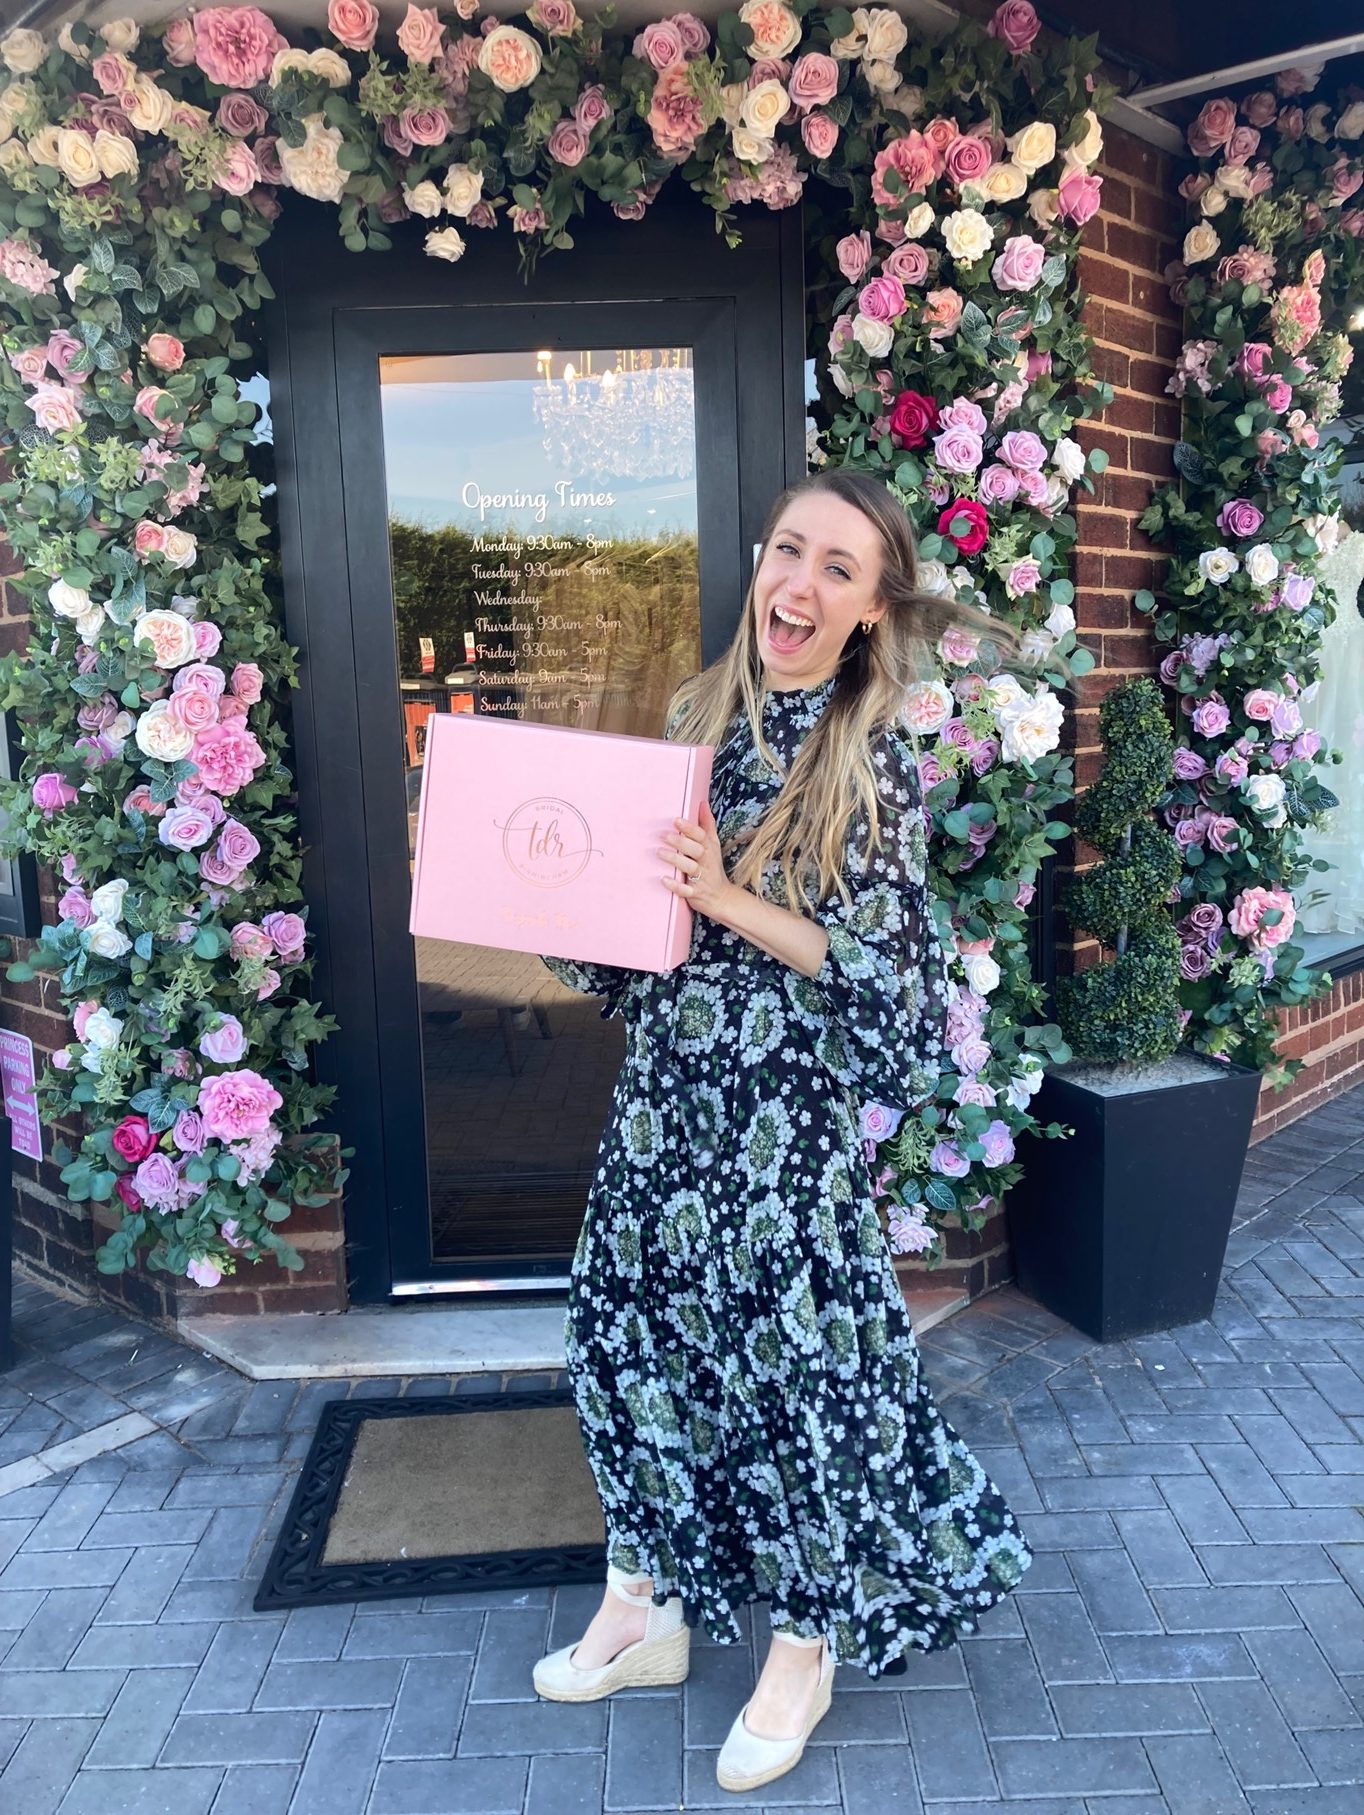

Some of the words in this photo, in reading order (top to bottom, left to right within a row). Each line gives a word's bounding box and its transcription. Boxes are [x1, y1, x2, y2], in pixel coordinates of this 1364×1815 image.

[462, 482, 549, 522] Opening
[554, 480, 616, 509] Times
[470, 537, 523, 559] Monday:
[526, 535, 573, 551] 9:30am
[586, 533, 613, 556] 8pm
[471, 563, 521, 586] Tuesday:
[524, 562, 570, 578] 9:30am
[584, 561, 611, 583] 8pm
[473, 589, 543, 612] Wednesday:
[475, 617, 534, 639] Thursday:
[595, 613, 622, 636] 8pm
[476, 643, 520, 666] Friday:
[581, 640, 608, 663] 5pm
[479, 669, 536, 692] Saturday:
[538, 668, 566, 683] 9am
[580, 667, 606, 689] 5pm
[480, 695, 528, 718] Sunday:
[573, 694, 600, 714] 5pm
[0, 1036, 29, 1058] PRINCESS
[3, 1056, 30, 1077] PARKING
[11, 1078, 26, 1094] ONLY
